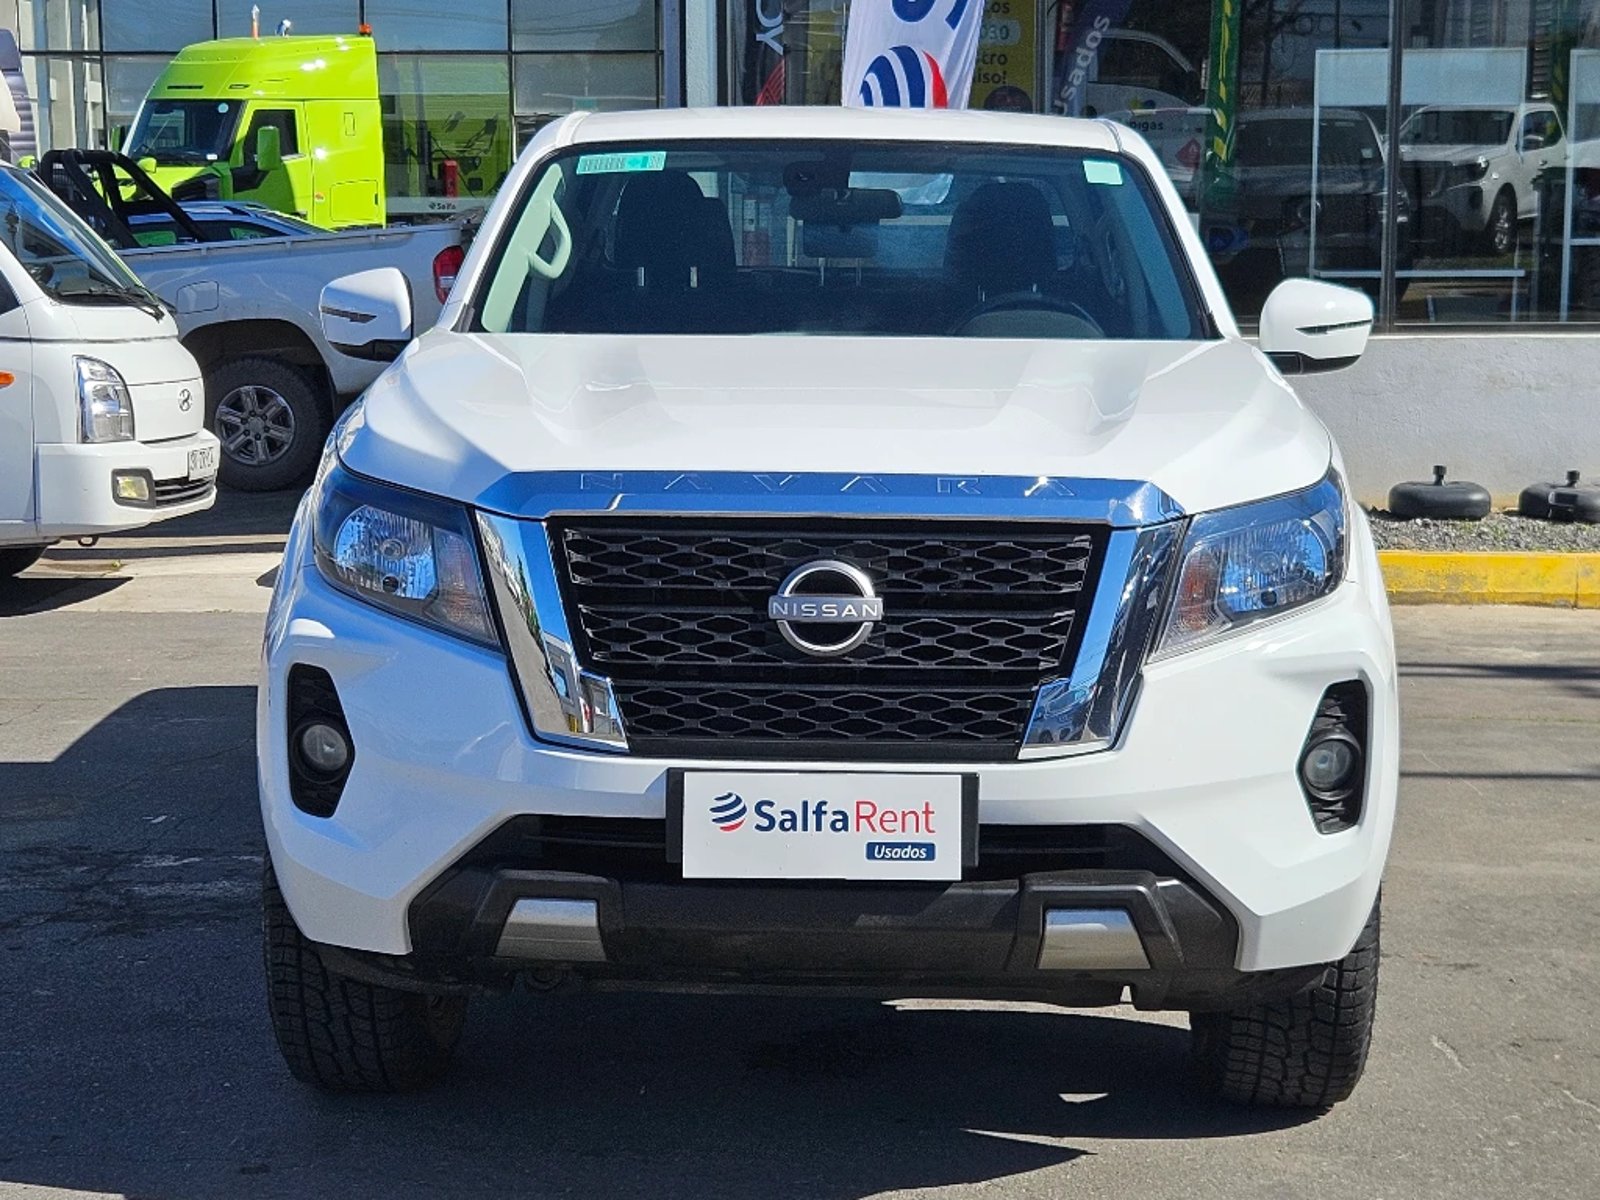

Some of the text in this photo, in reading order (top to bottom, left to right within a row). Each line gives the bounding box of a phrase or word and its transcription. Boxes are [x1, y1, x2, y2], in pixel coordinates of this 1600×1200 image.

[579, 472, 1077, 498] NAVARA
[772, 601, 878, 618] NISSAN
[754, 799, 936, 834] SalfaRent
[873, 844, 928, 860] Usados
